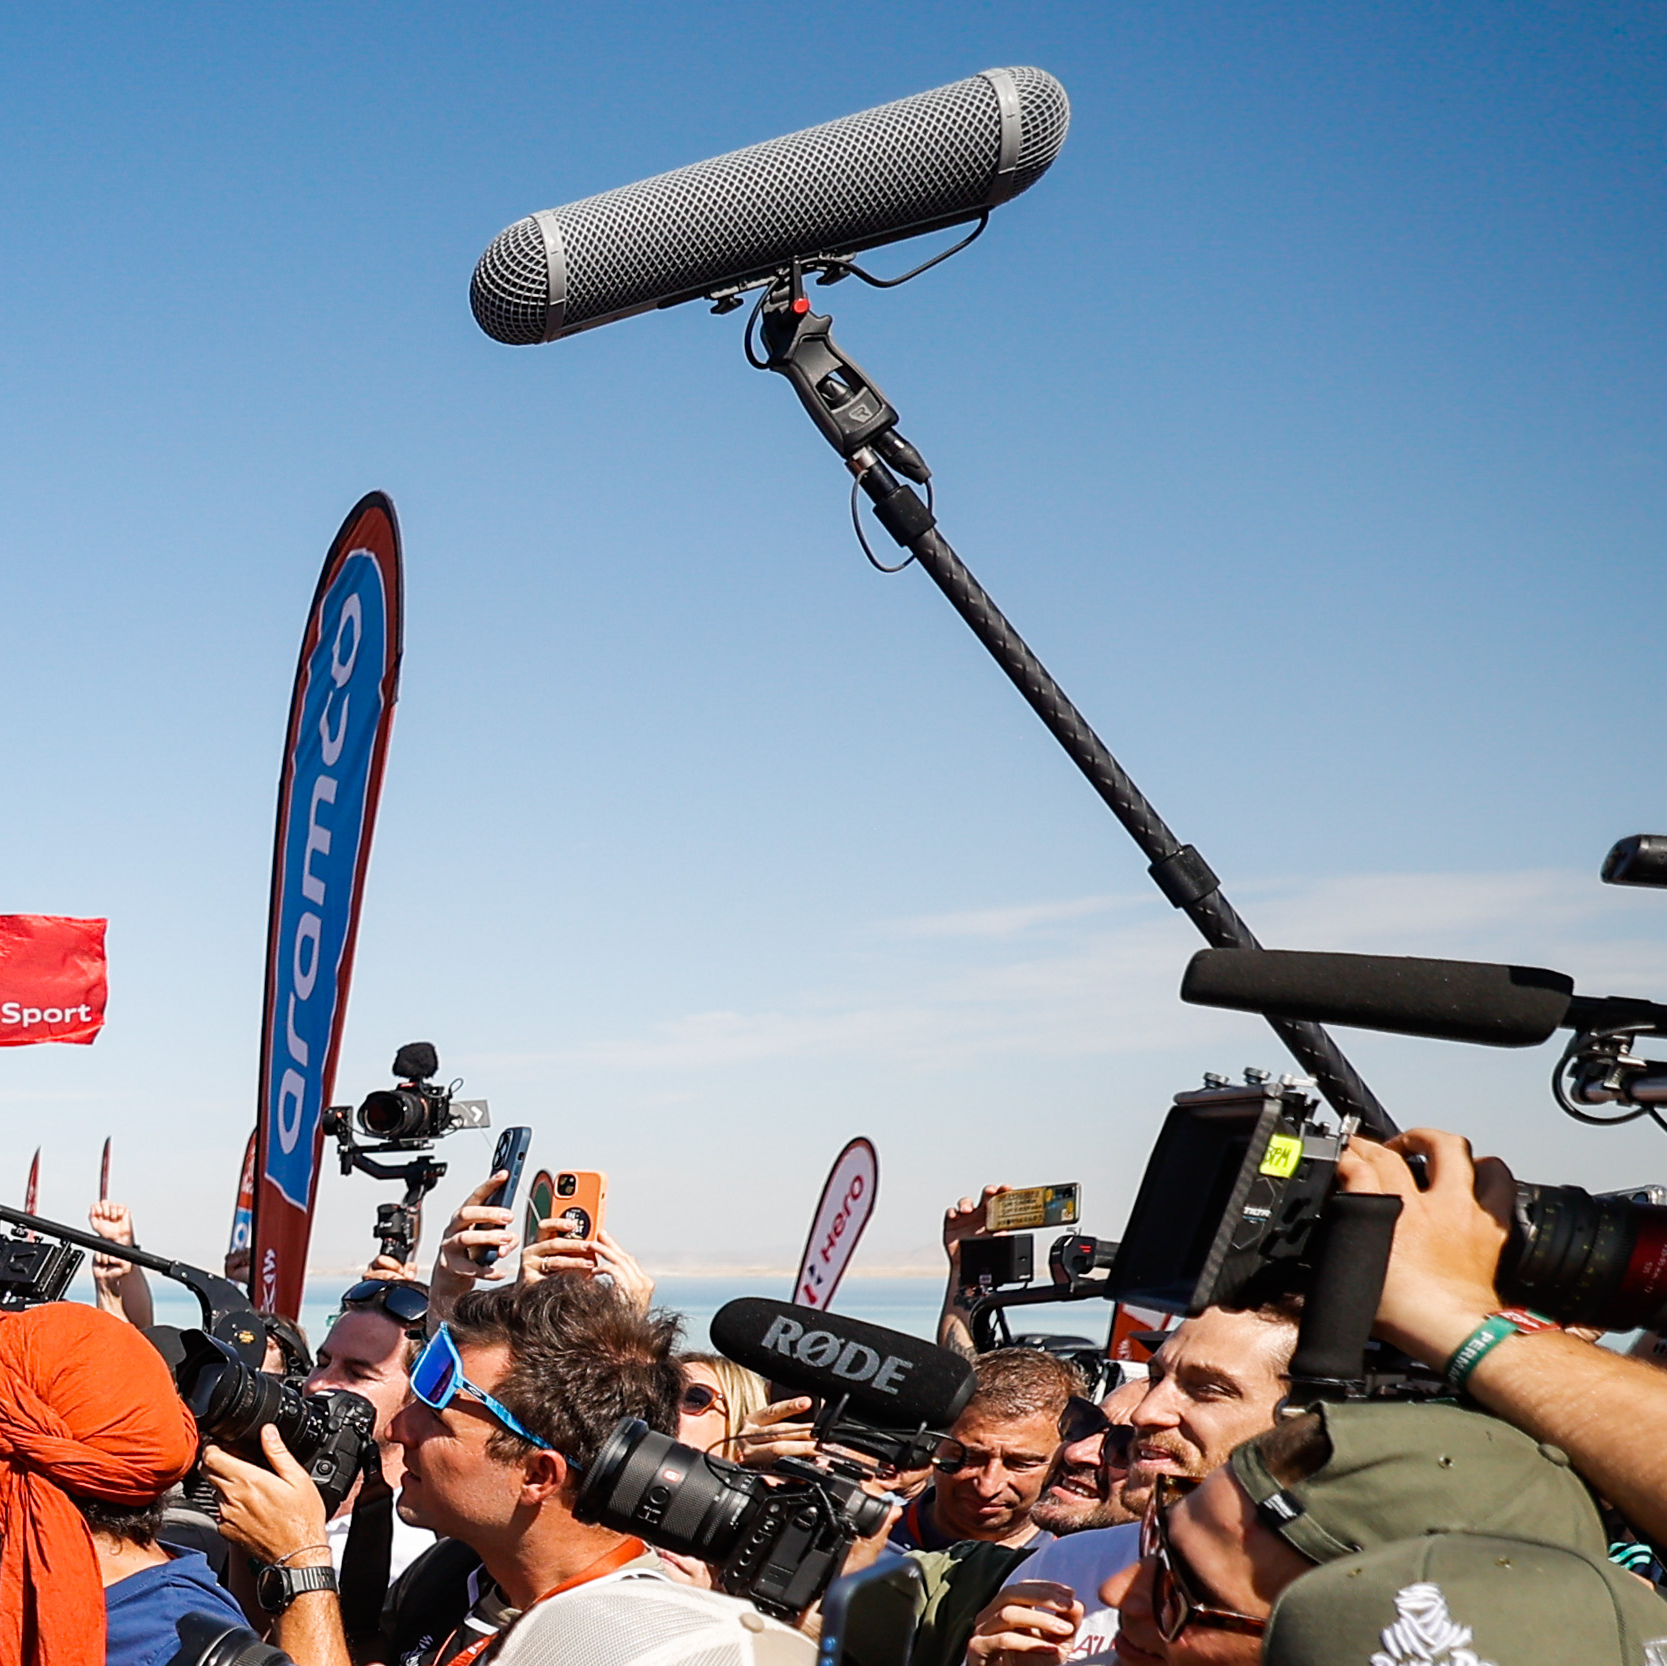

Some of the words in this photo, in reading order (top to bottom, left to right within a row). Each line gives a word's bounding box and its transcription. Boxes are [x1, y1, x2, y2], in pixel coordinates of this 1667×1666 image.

[278, 590, 361, 1153] aramco
[1, 1002, 91, 1027] Sport
[822, 1174, 864, 1264] Hero
[760, 1317, 913, 1394] RØDE
